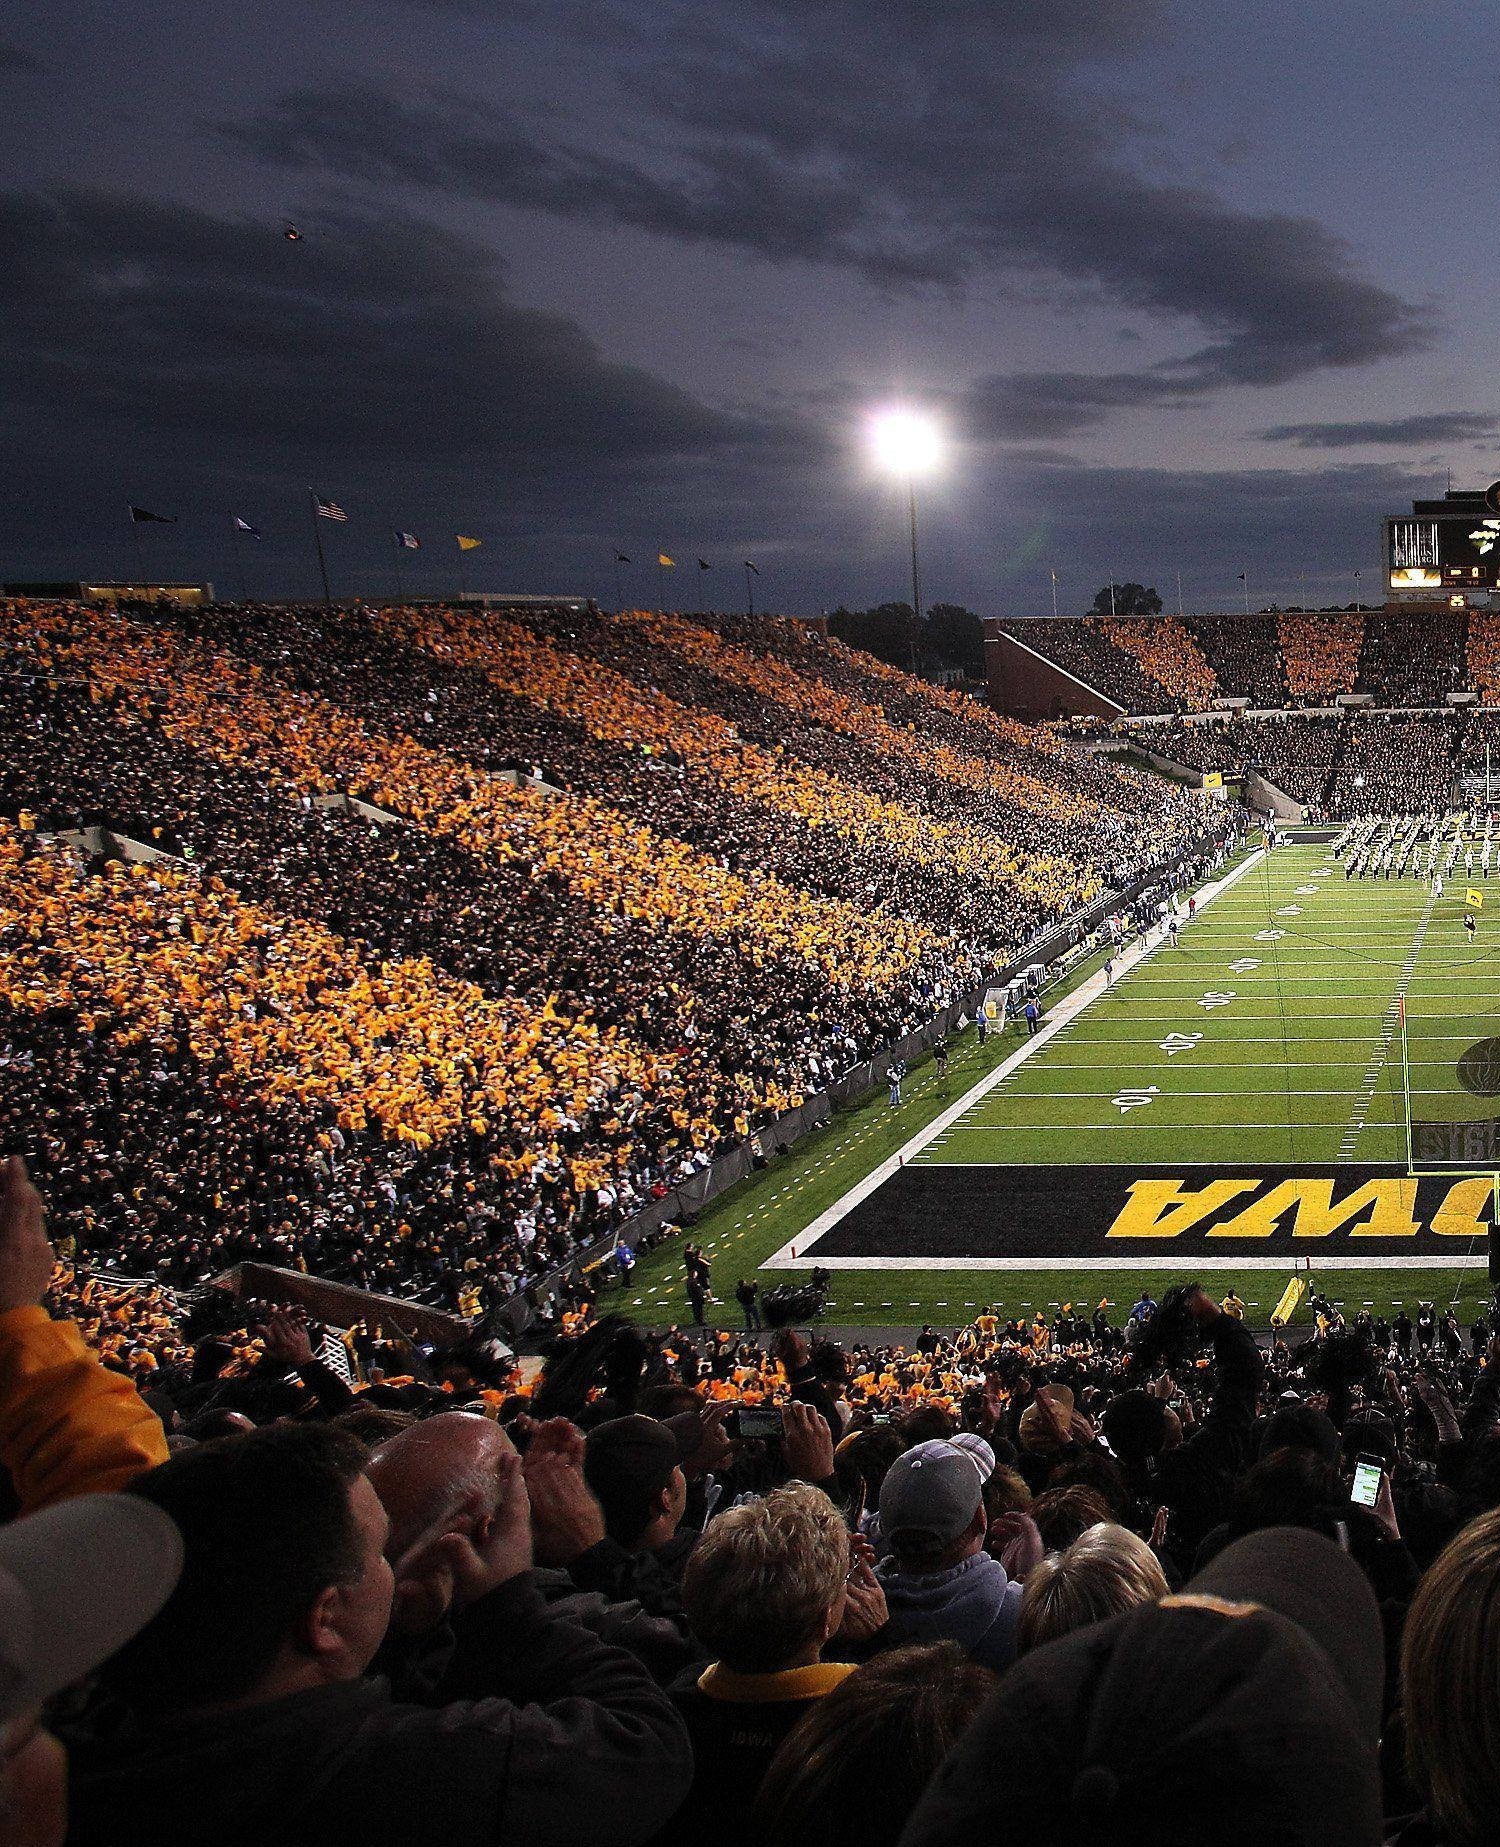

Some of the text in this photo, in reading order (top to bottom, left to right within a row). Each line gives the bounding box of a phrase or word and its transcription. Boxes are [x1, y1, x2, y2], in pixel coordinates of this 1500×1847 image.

[1197, 990, 1238, 1007] 30
[1158, 1031, 1204, 1051] 20
[1110, 1084, 1161, 1107] 10
